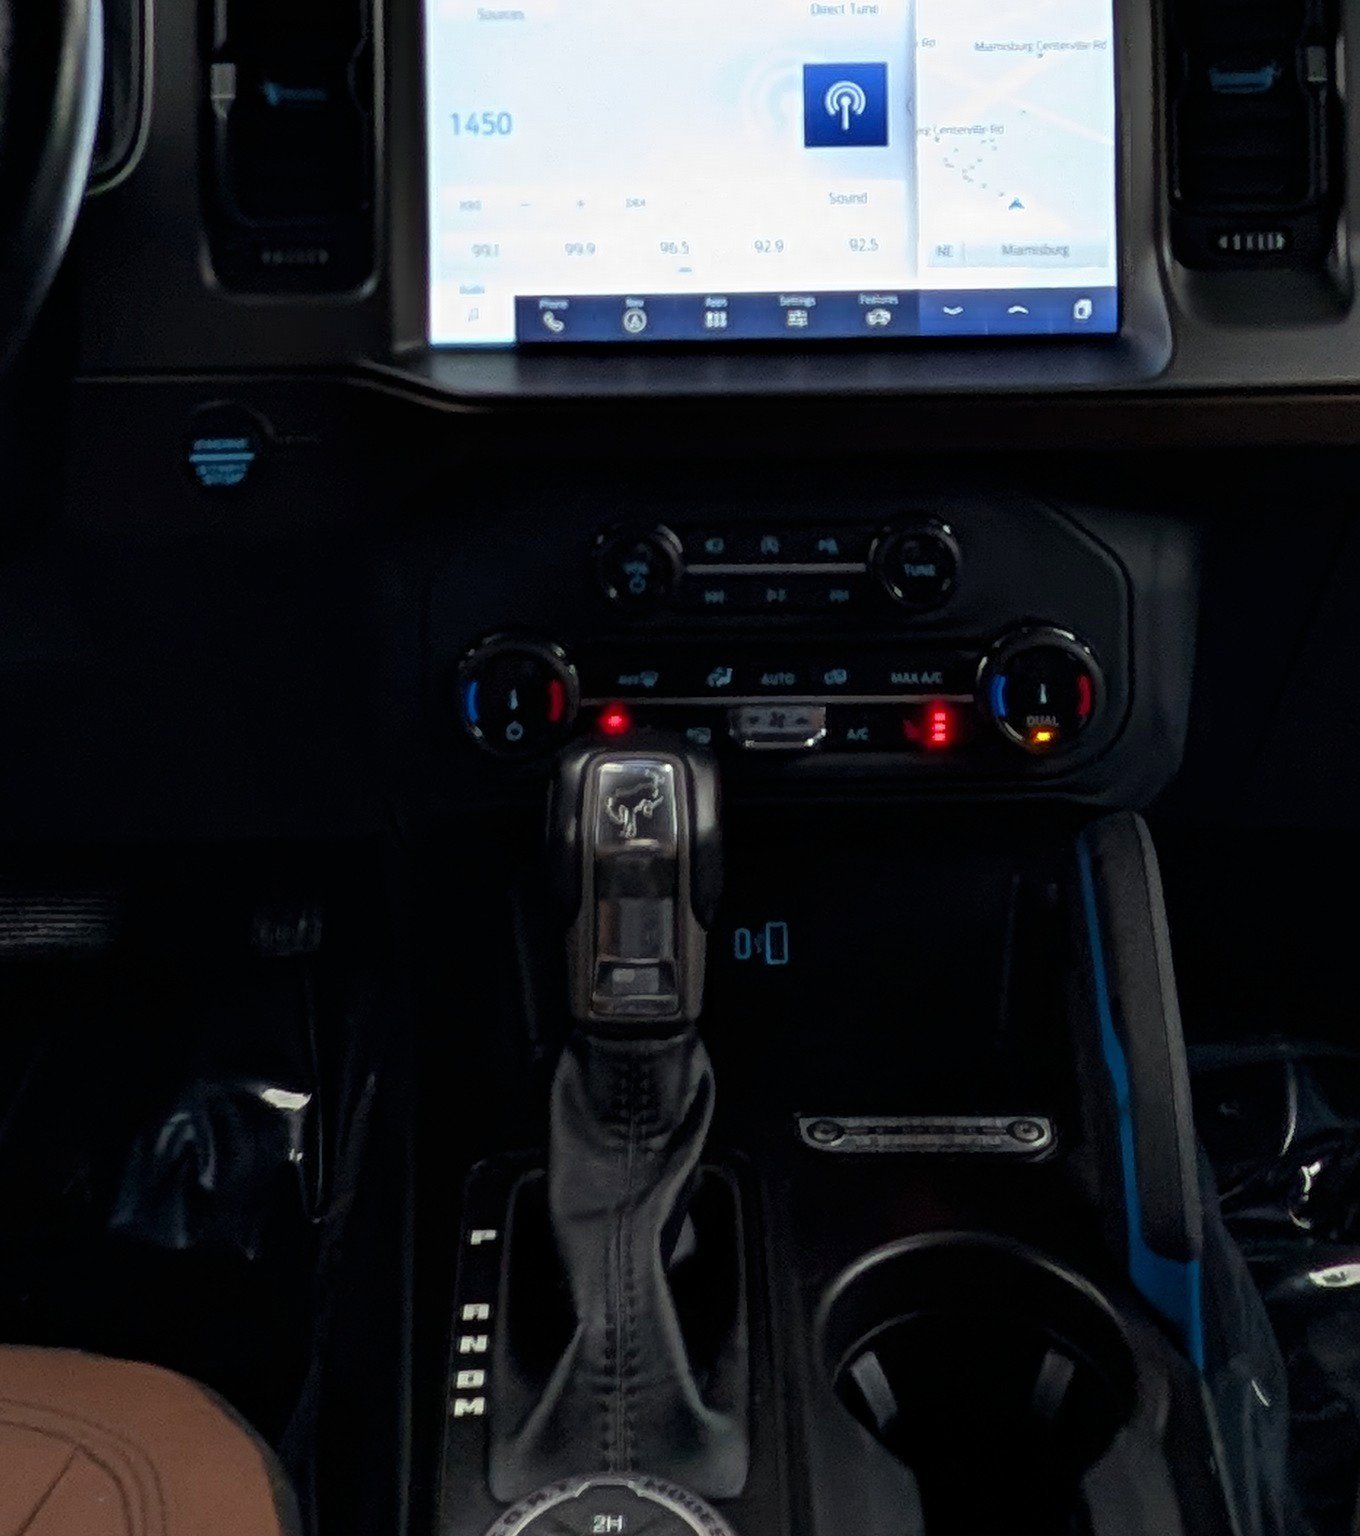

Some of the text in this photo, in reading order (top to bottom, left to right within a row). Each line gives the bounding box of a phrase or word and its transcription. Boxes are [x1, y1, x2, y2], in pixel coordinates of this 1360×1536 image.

[451, 111, 513, 136] 1450
[828, 191, 868, 206] Sound
[760, 672, 796, 686] AUTO
[890, 672, 919, 685] MAX
[1025, 715, 1060, 726] DUAL
[459, 1334, 488, 1354] N
[453, 1396, 486, 1418] M
[593, 1514, 623, 1533] 2H
